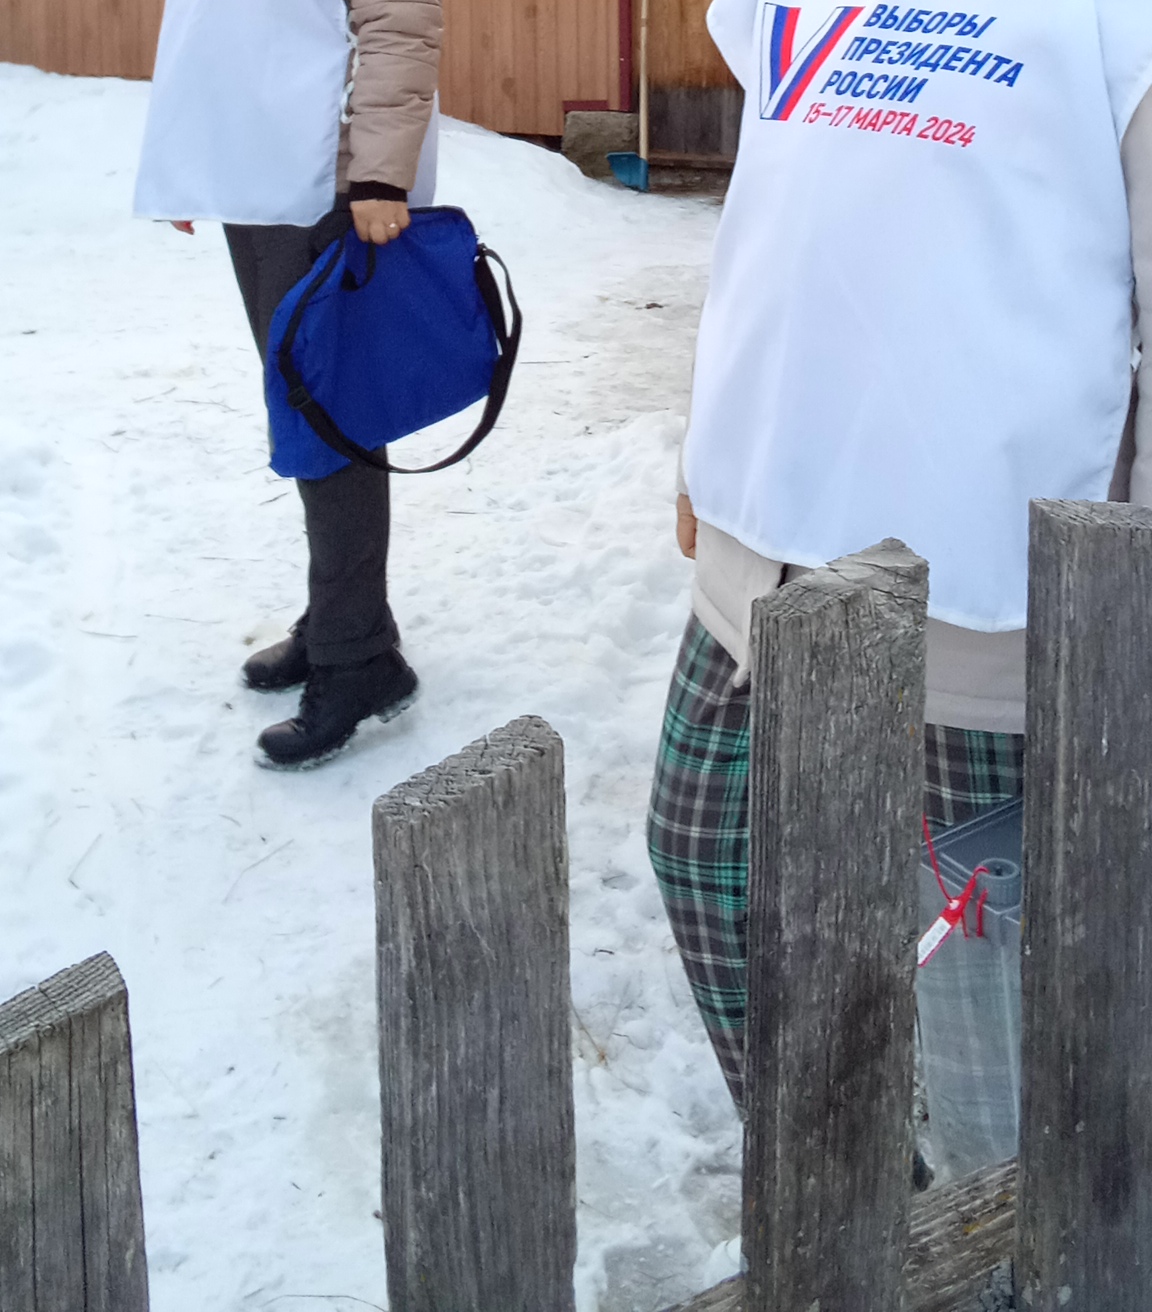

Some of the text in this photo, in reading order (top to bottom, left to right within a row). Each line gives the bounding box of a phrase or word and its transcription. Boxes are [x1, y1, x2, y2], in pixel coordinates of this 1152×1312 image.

[863, 3, 998, 39] ВЫБОРЫ
[840, 36, 1025, 88] ПРЕЗИДЕНТА
[819, 69, 929, 104] РОССИИ
[846, 106, 920, 137] МАРТА
[916, 115, 977, 148] 2024
